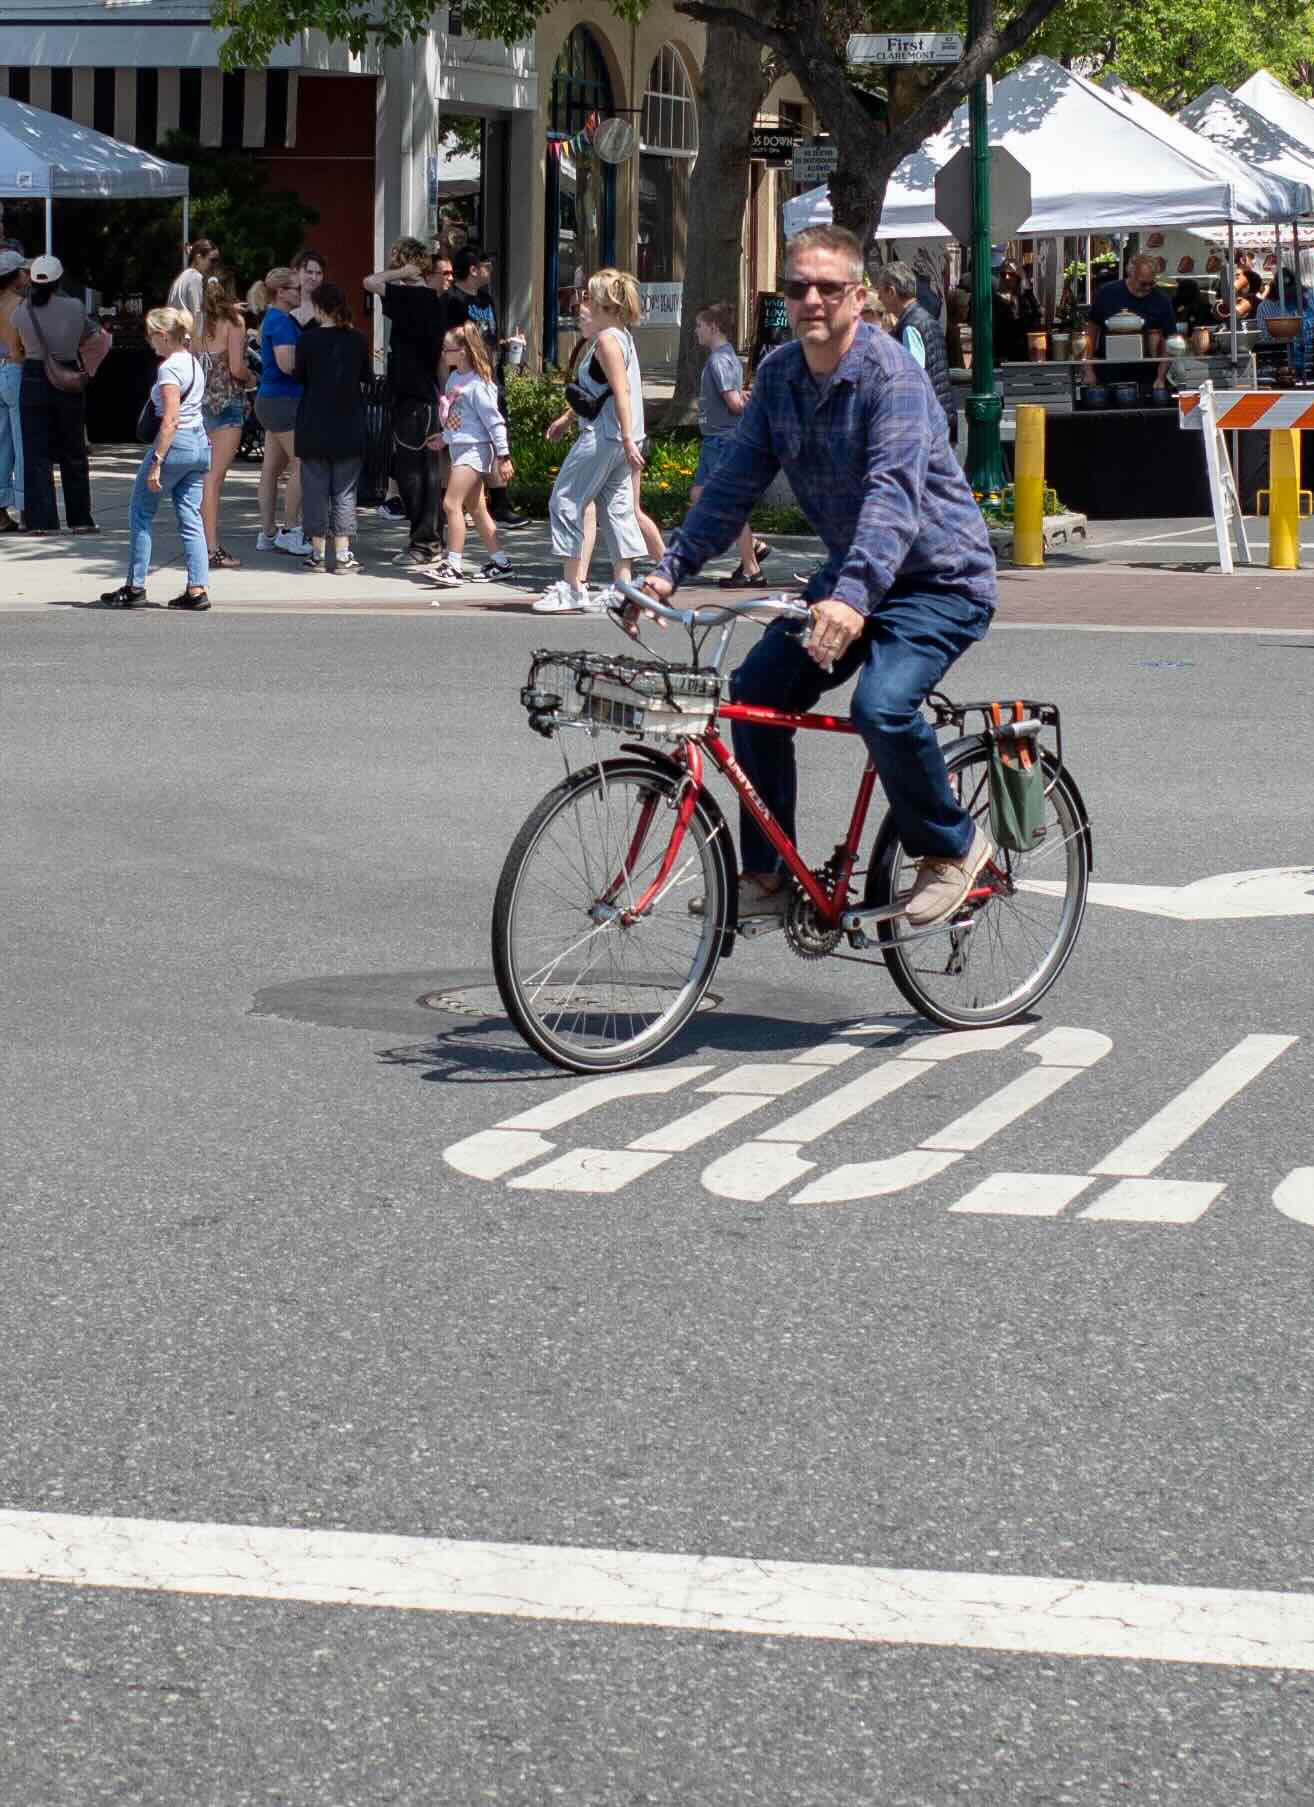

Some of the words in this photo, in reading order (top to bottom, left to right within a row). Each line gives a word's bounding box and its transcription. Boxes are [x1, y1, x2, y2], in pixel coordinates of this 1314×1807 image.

[887, 37, 924, 51] First
[876, 51, 935, 60] CLAREMONT
[763, 136, 792, 147] DOWN
